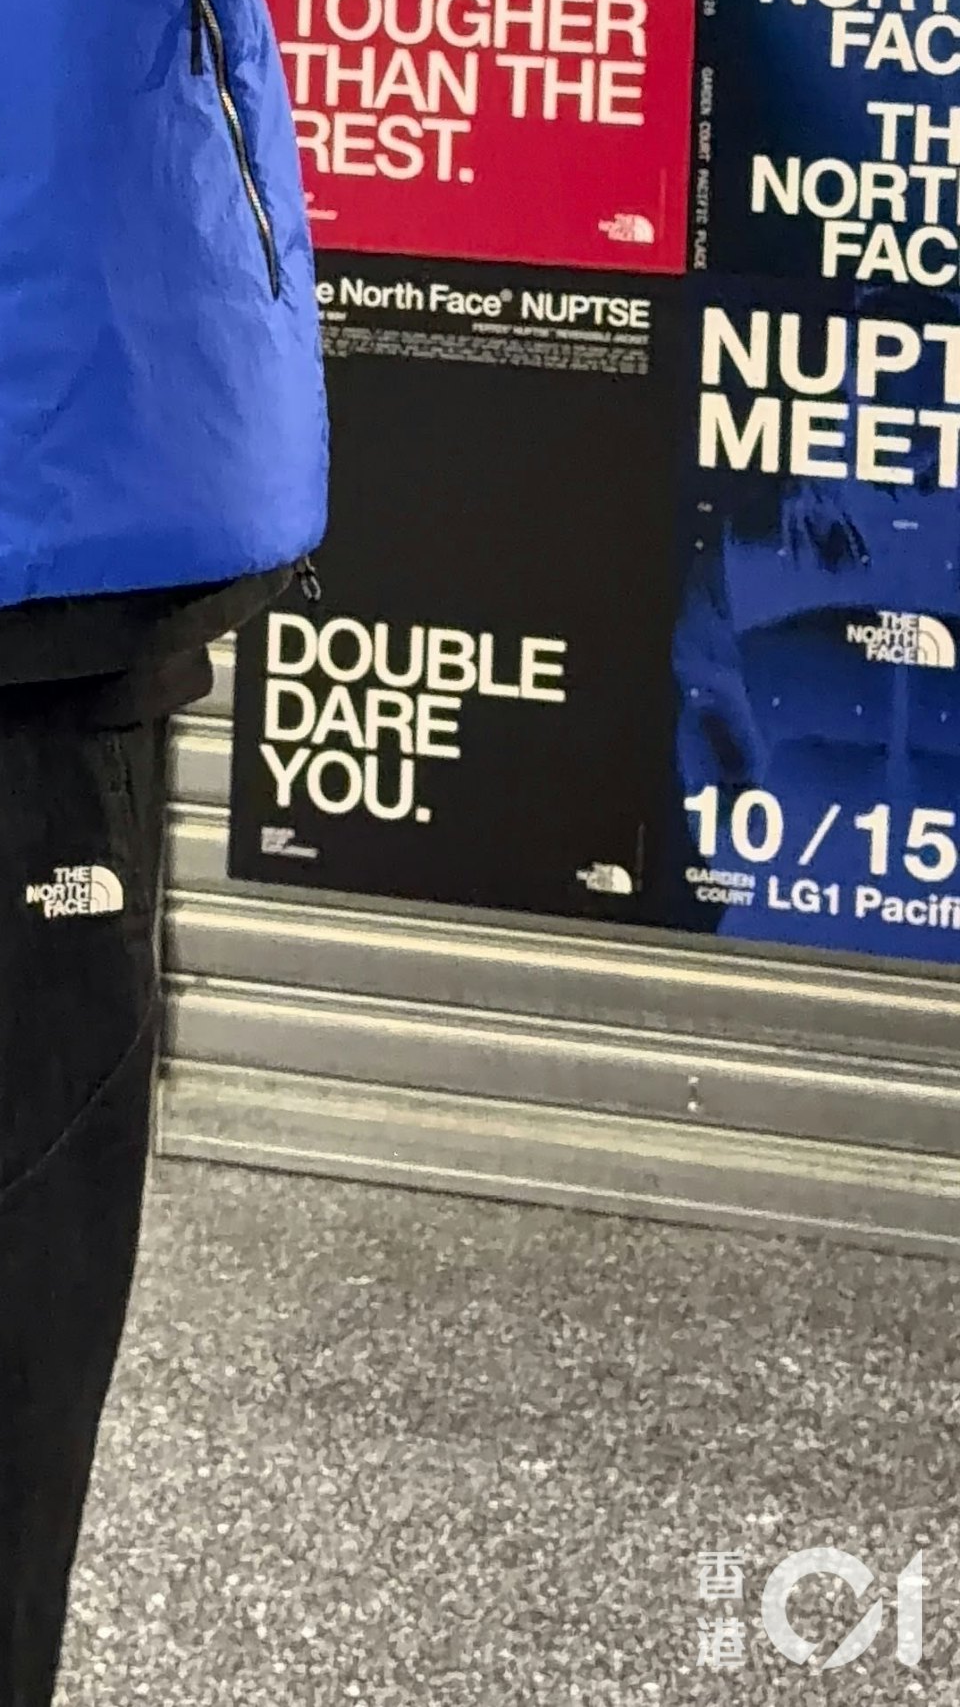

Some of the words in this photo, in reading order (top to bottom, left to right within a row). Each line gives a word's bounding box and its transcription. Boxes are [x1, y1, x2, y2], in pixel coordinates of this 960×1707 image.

[830, 9, 960, 76] FAC
[280, 42, 479, 116] THAN
[496, 54, 646, 126] THE
[292, 109, 475, 184] REST.
[866, 101, 960, 166] TH
[750, 154, 960, 226] NORT
[821, 220, 960, 288] FAC
[340, 277, 423, 311] North
[520, 291, 652, 330] NUPTSE
[701, 306, 960, 405] NUPT
[697, 391, 960, 489] MEET
[846, 624, 918, 648] NORTH
[877, 610, 918, 630] THE
[267, 612, 567, 702] DOUBLE
[866, 644, 918, 665] FACE
[264, 678, 462, 759] DARE
[259, 742, 432, 823] YOU.
[26, 883, 91, 904] NORTH
[53, 866, 91, 883] THE
[686, 867, 756, 889] GARDEN
[767, 875, 840, 916] LG1
[695, 886, 756, 906] COURT
[44, 899, 91, 919] FACE
